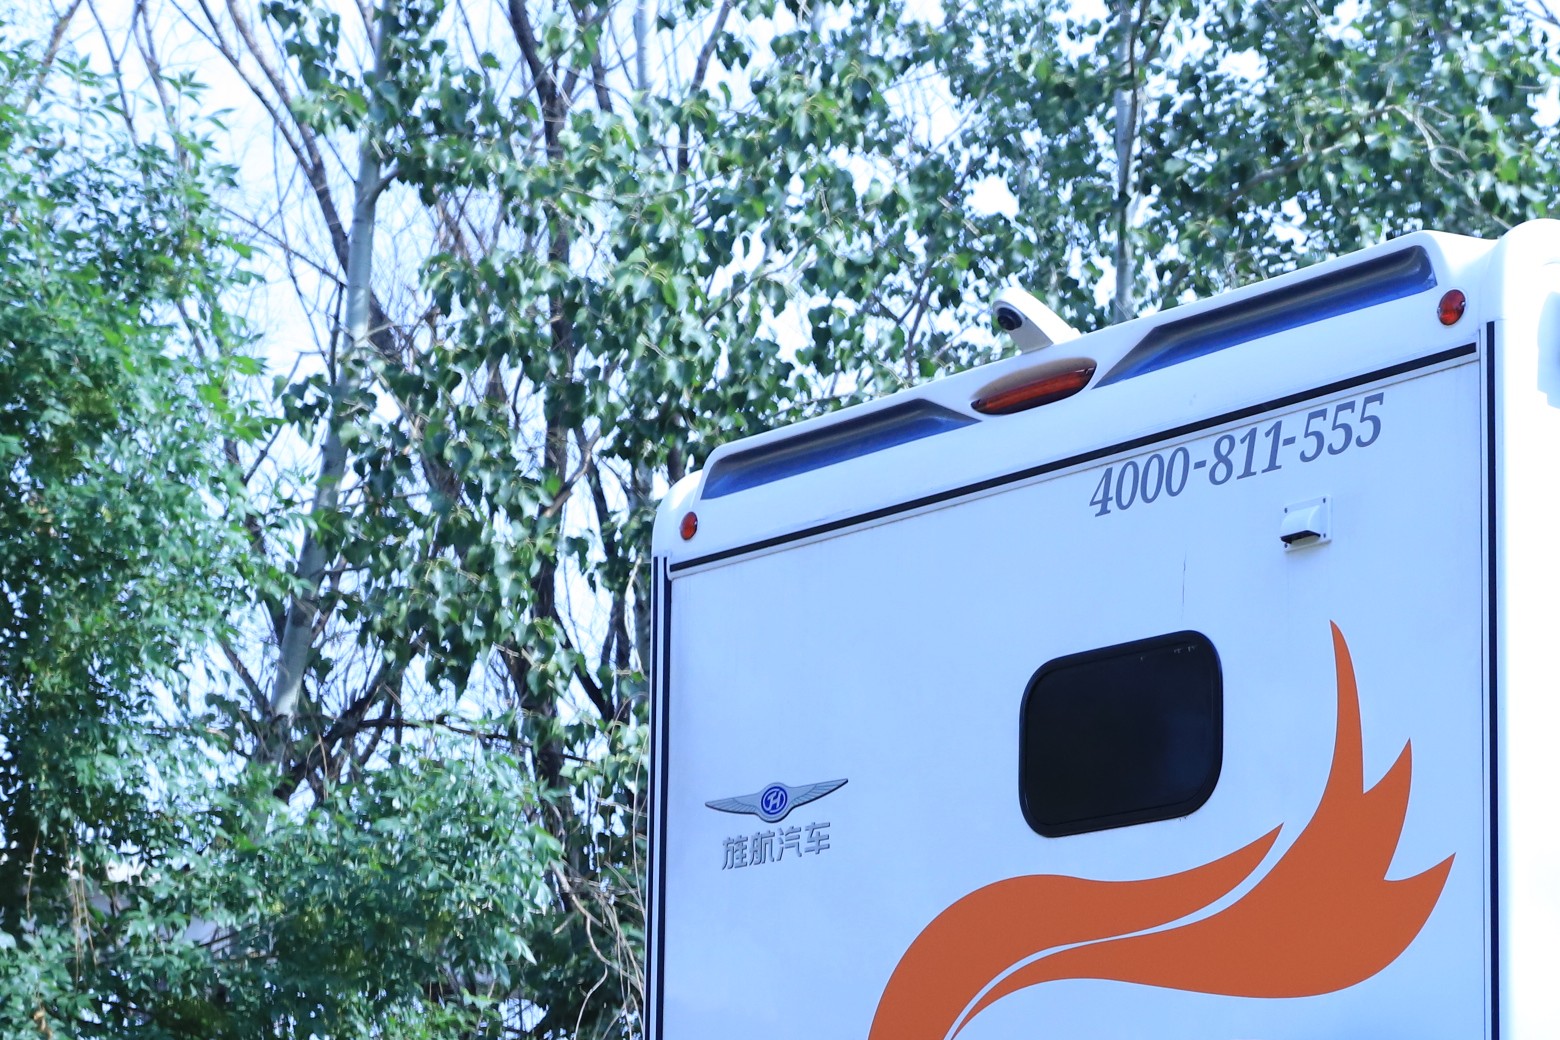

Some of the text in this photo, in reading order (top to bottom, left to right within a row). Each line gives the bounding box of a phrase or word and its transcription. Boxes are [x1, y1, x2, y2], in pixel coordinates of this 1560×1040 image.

[1089, 391, 1385, 518] 4000-811-555
[721, 821, 831, 871] 旌航汽车
